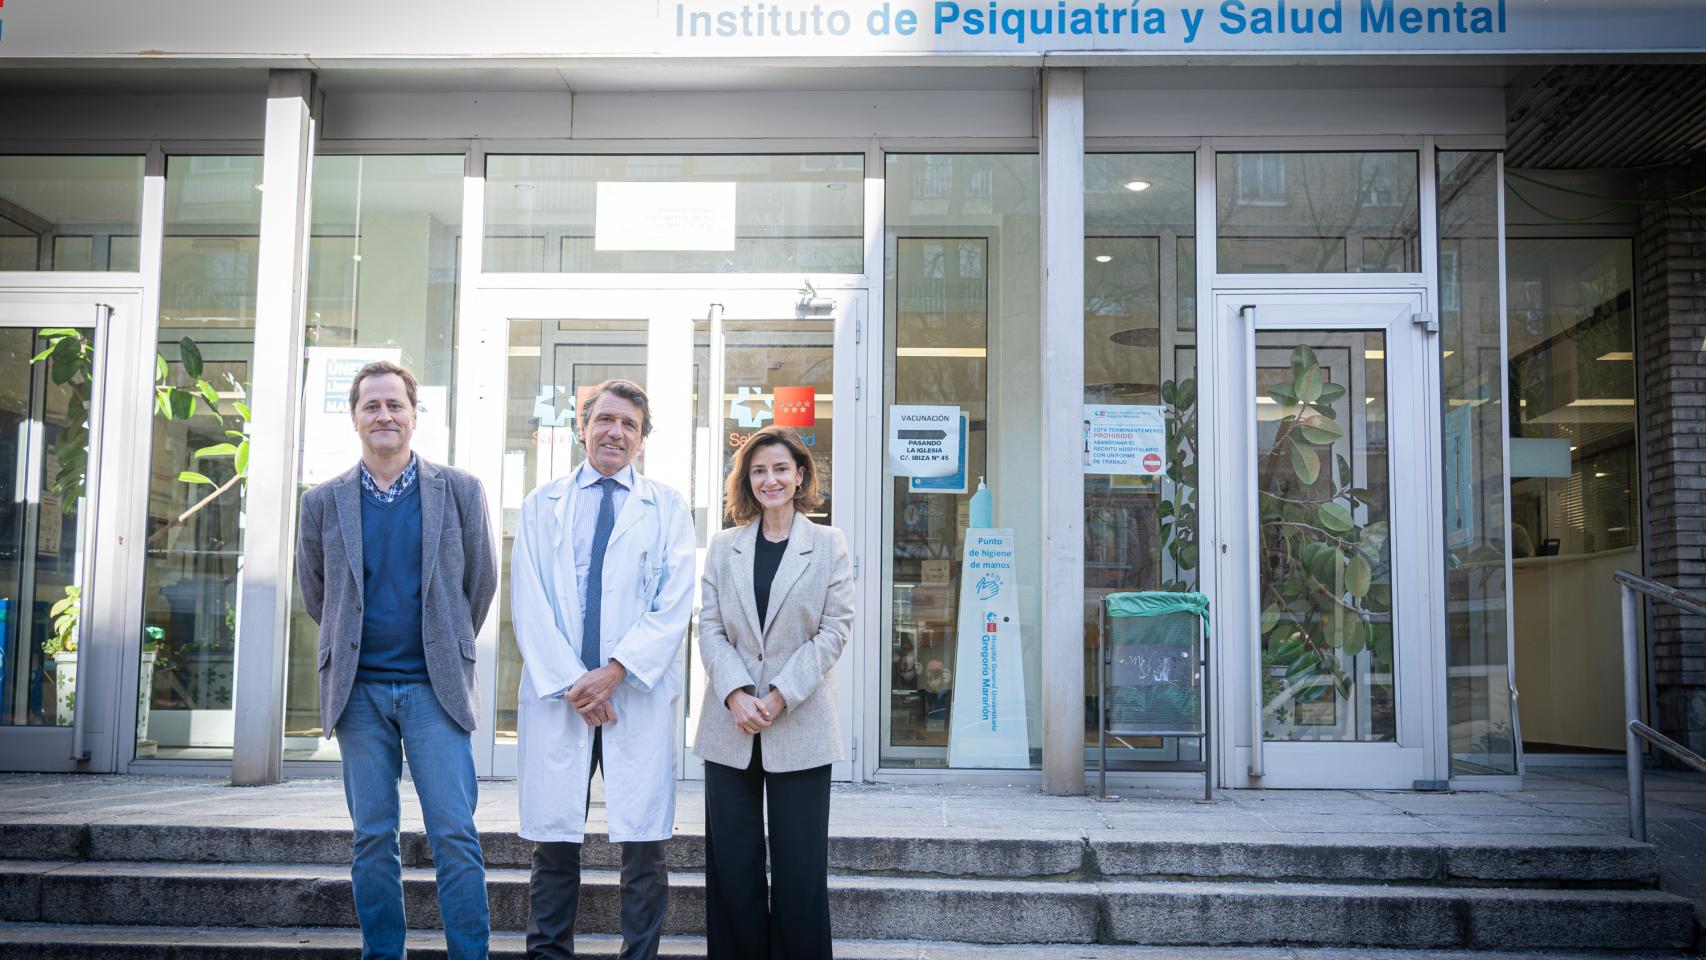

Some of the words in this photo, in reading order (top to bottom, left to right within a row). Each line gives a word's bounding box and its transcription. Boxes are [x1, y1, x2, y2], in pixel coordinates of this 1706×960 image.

[676, 3, 852, 37] Instituto
[867, 2, 918, 36] de
[934, 0, 1166, 44] Psiquiatría
[1182, 7, 1204, 44] y
[1219, 0, 1333, 35] Salud
[1360, 0, 1507, 34] Mental
[901, 414, 950, 422] VACUNACIÓN
[969, 549, 980, 557] de
[981, 549, 1012, 558] higiene
[970, 560, 981, 568] de
[981, 635, 991, 676] Gregorio
[982, 678, 991, 721] Marañón
